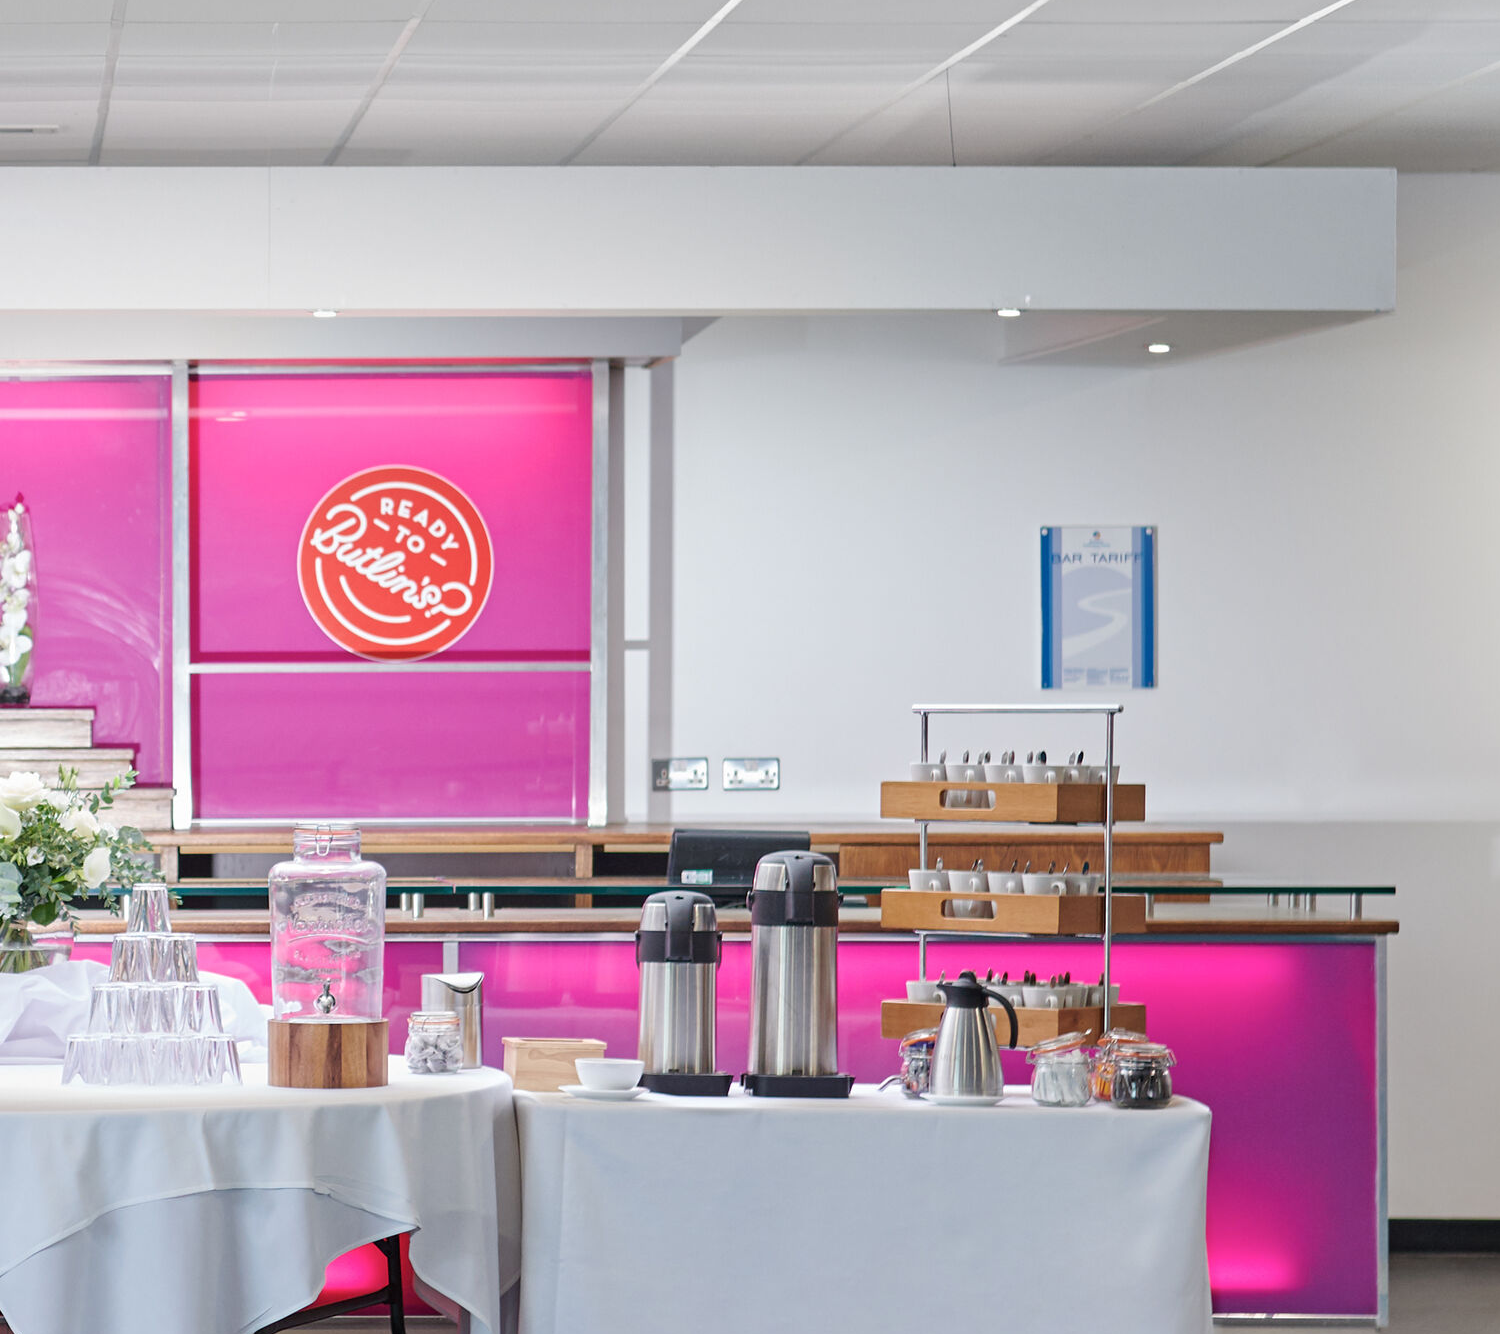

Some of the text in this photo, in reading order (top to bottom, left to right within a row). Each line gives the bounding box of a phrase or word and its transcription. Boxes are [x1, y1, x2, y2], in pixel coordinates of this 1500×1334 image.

[380, 497, 460, 550] READY
[395, 525, 426, 553] TO
[1050, 553, 1144, 564] BAR TARIFF
